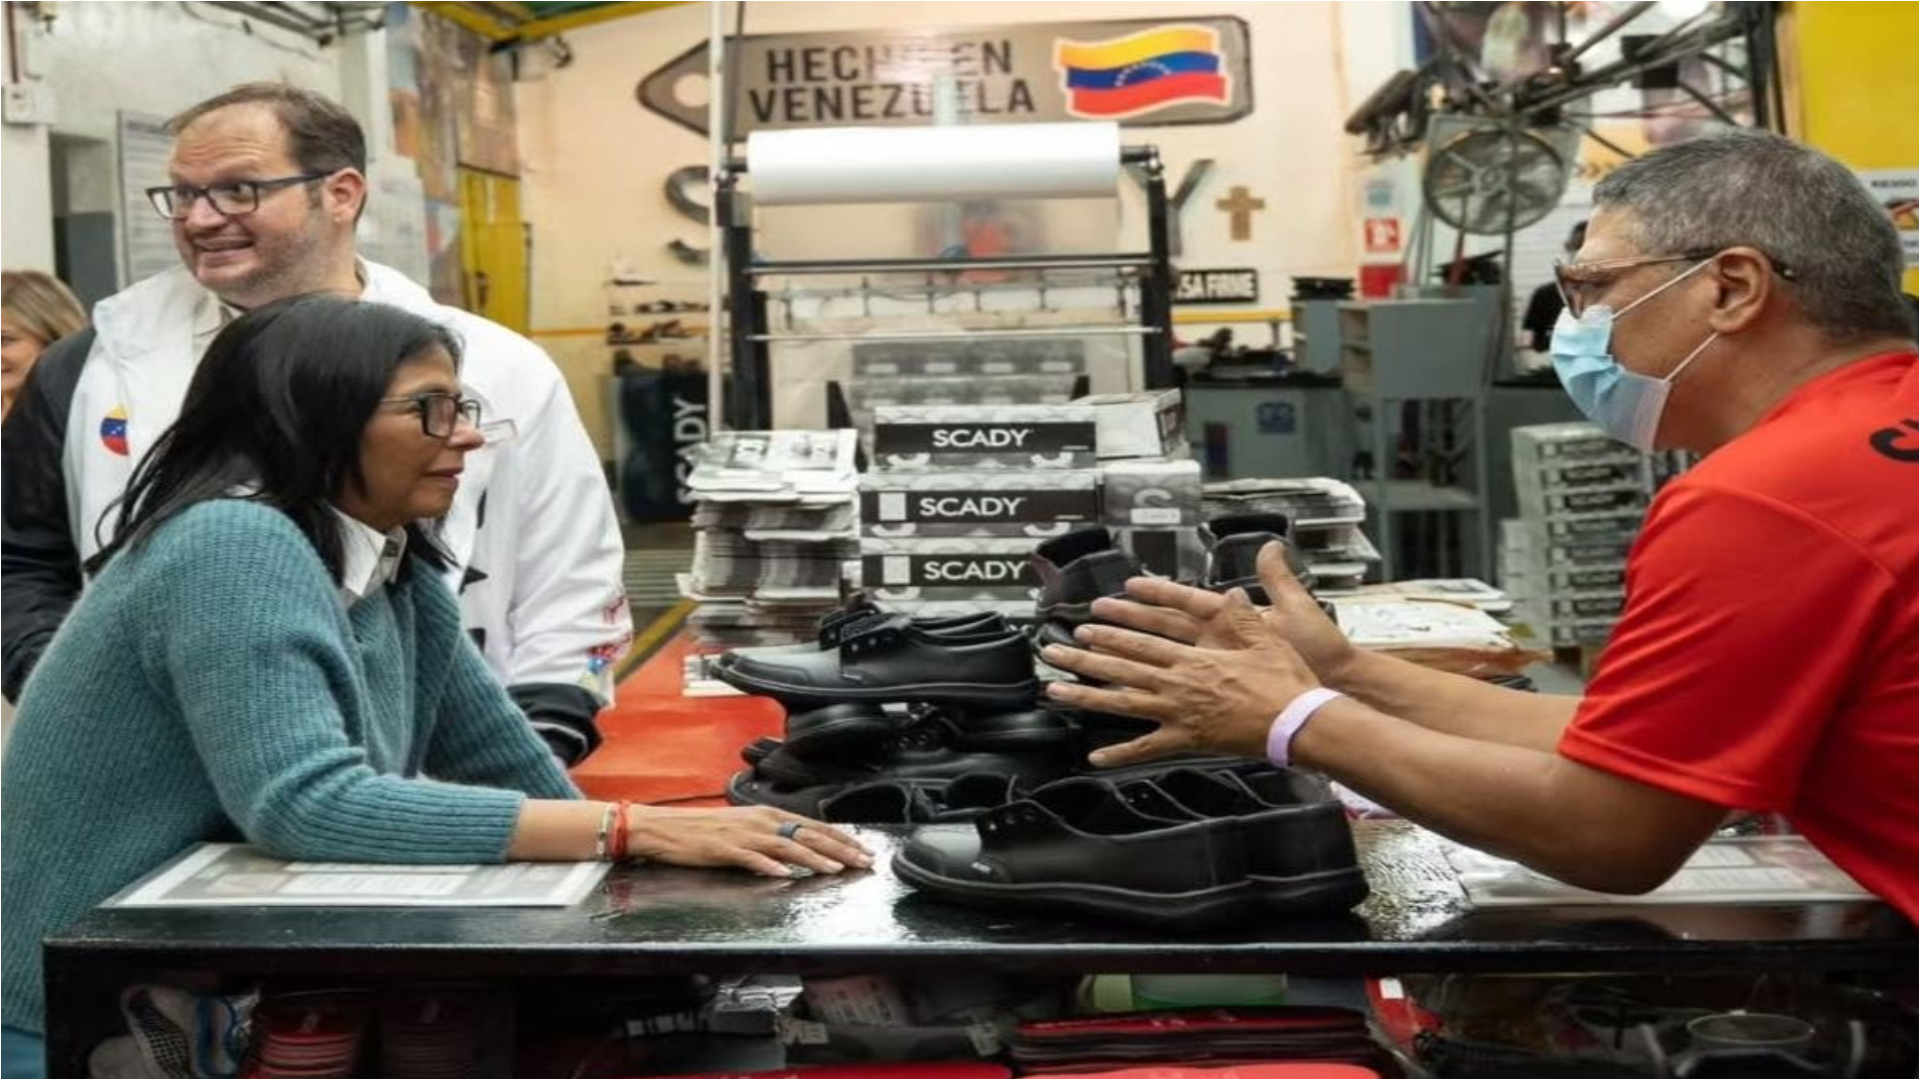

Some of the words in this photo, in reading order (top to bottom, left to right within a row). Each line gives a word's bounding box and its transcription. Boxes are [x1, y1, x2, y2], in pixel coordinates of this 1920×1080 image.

[766, 45, 924, 83] HECH
[951, 40, 1011, 77] EN
[932, 428, 1029, 448] SCADY
[919, 497, 1021, 517] SCADY
[923, 561, 1025, 581] SCADY
